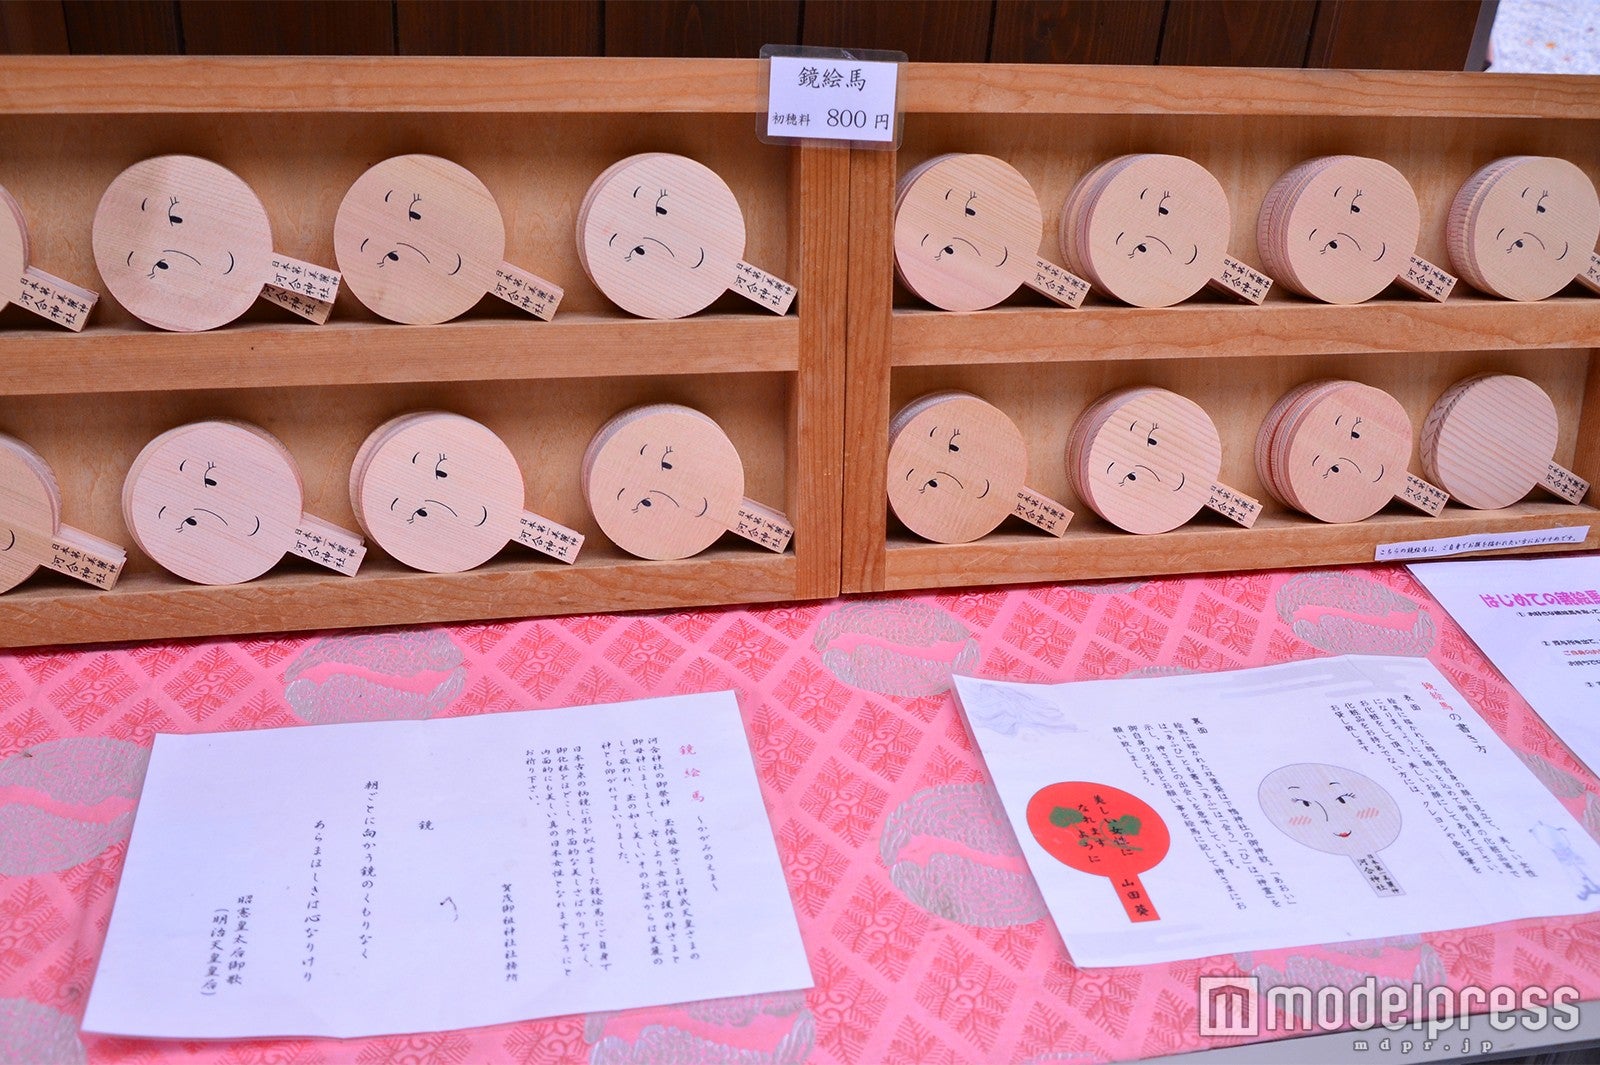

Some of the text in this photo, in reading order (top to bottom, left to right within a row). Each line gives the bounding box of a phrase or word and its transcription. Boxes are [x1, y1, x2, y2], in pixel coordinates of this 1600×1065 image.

[797, 66, 866, 92] 鏡絵馬
[771, 108, 889, 131] 初穂料 800 円
[273, 272, 330, 299] 河合神社
[734, 274, 782, 306] 河合神社
[1034, 272, 1078, 302] 河合神社
[1220, 270, 1262, 299] 河合神社
[1406, 267, 1444, 296] 河合神社
[20, 290, 77, 325] 河合神社
[494, 281, 545, 315] 河合神社
[1014, 503, 1057, 531] 河合神社
[518, 529, 568, 557] 河合神社
[736, 521, 782, 548] 河合神社
[293, 539, 346, 568] 河合神社
[51, 554, 107, 584] 河合神社
[418, 819, 434, 831] 鏡
[359, 780, 379, 960] 朝ごとに向かう鏡のくもりなく
[1121, 878, 1149, 917] 山田葵
